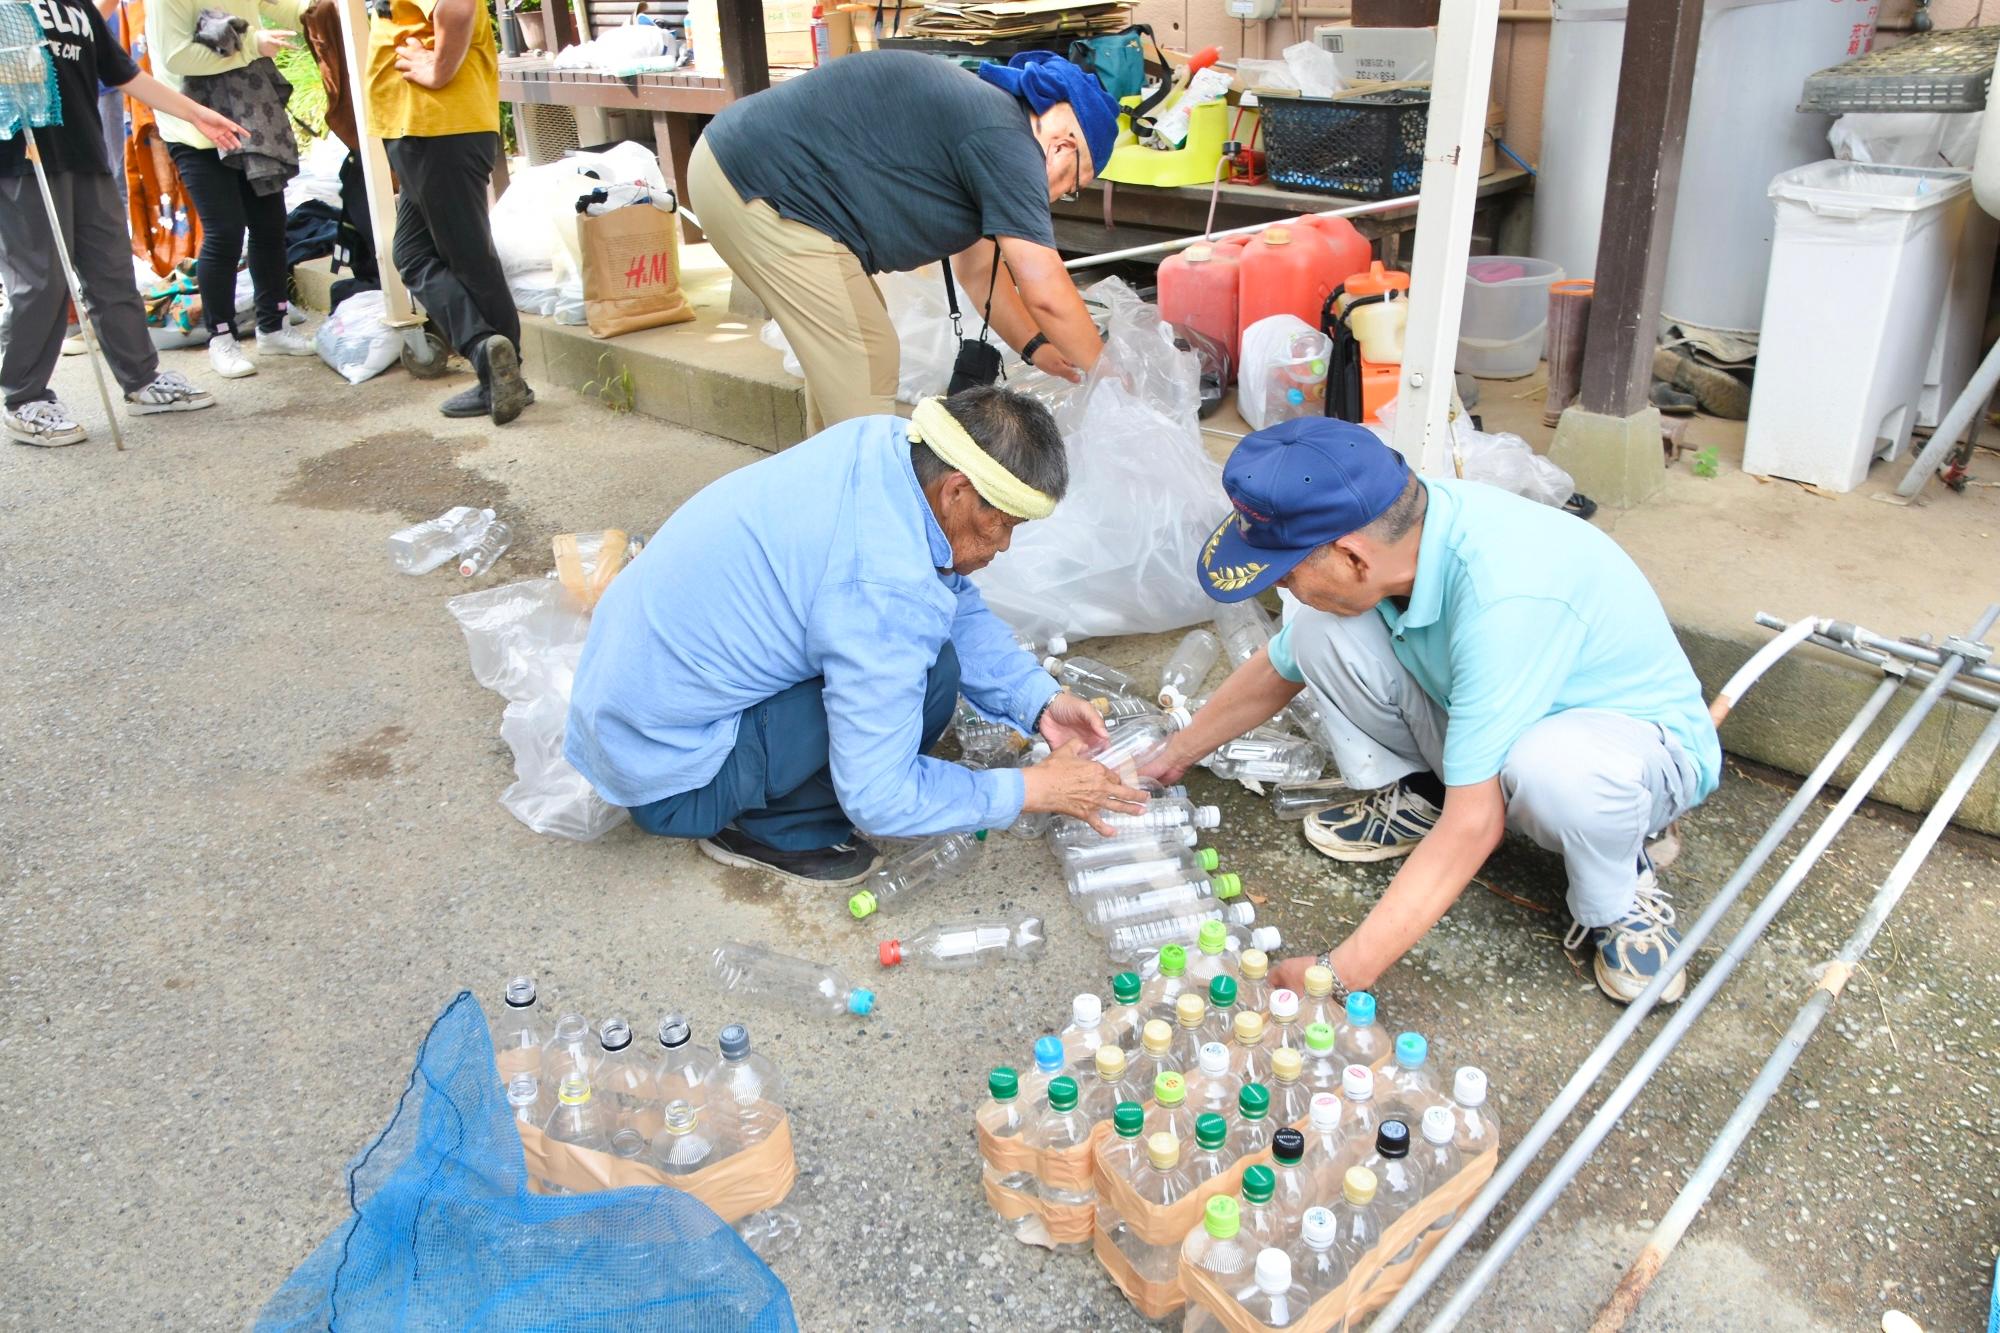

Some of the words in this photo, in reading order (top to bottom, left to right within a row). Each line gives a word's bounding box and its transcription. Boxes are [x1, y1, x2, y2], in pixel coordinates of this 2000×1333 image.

[31, 0, 94, 42] ELIX
[62, 43, 82, 61] CAT
[624, 252, 667, 288] H&M
